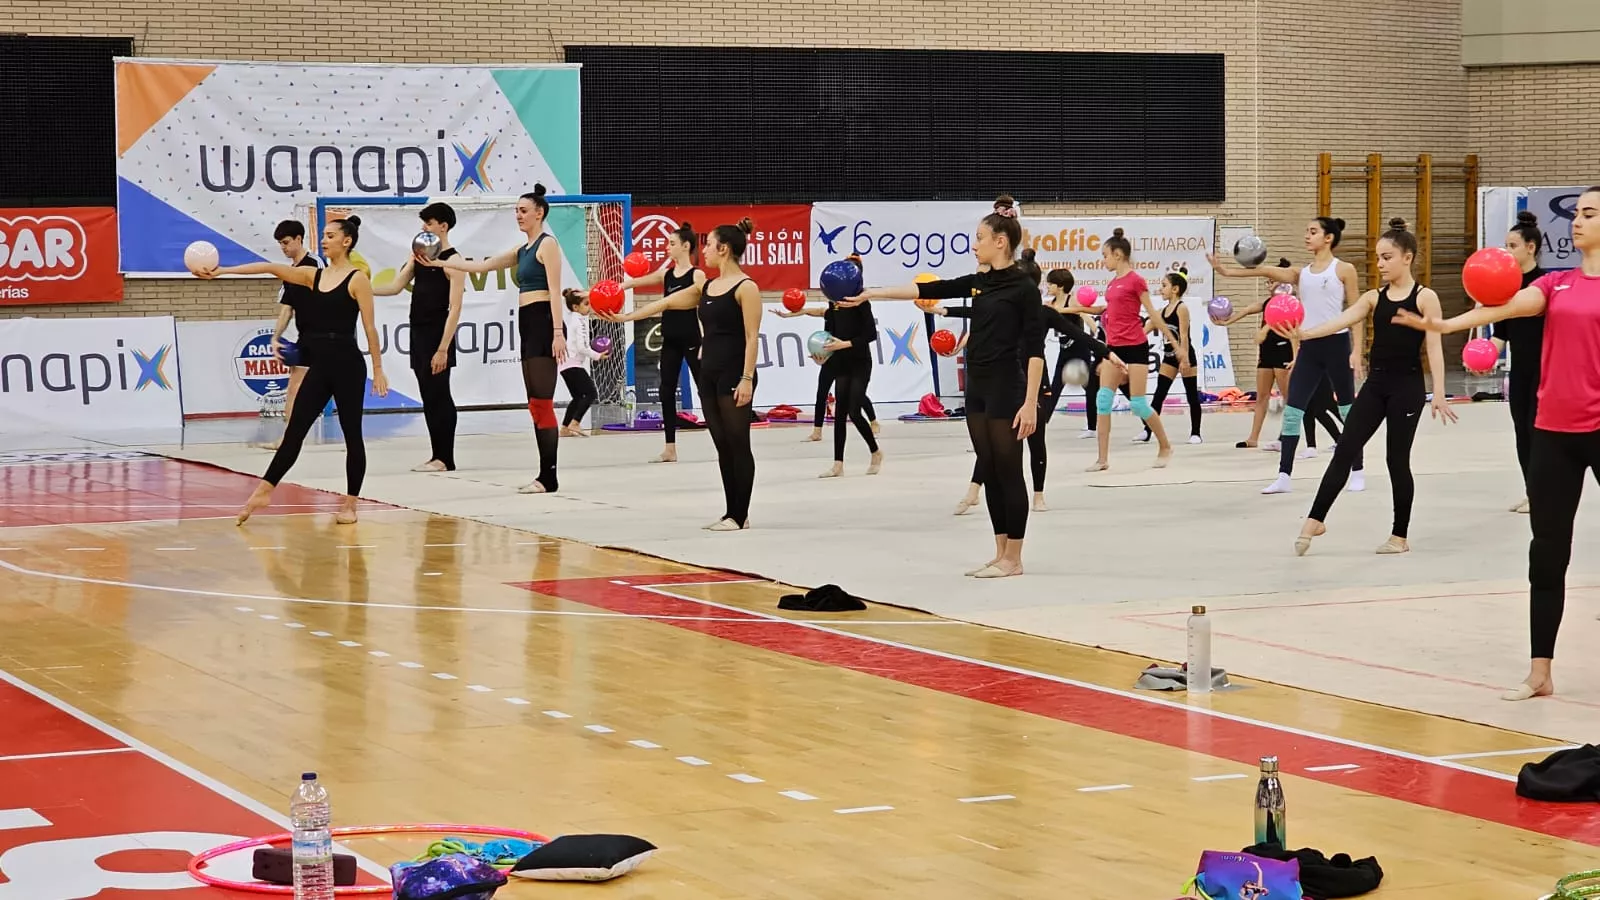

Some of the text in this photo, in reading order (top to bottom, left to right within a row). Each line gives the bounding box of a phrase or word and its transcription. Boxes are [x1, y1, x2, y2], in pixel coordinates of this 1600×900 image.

[200, 129, 497, 197] wanapix
[642, 237, 665, 249] RF
[853, 220, 970, 268] begga
[1021, 228, 1206, 251] traffic LTIMARCA
[768, 242, 804, 265] SALA
[0, 285, 29, 299] rías
[1, 339, 173, 405] napix
[244, 360, 291, 376] MARC
